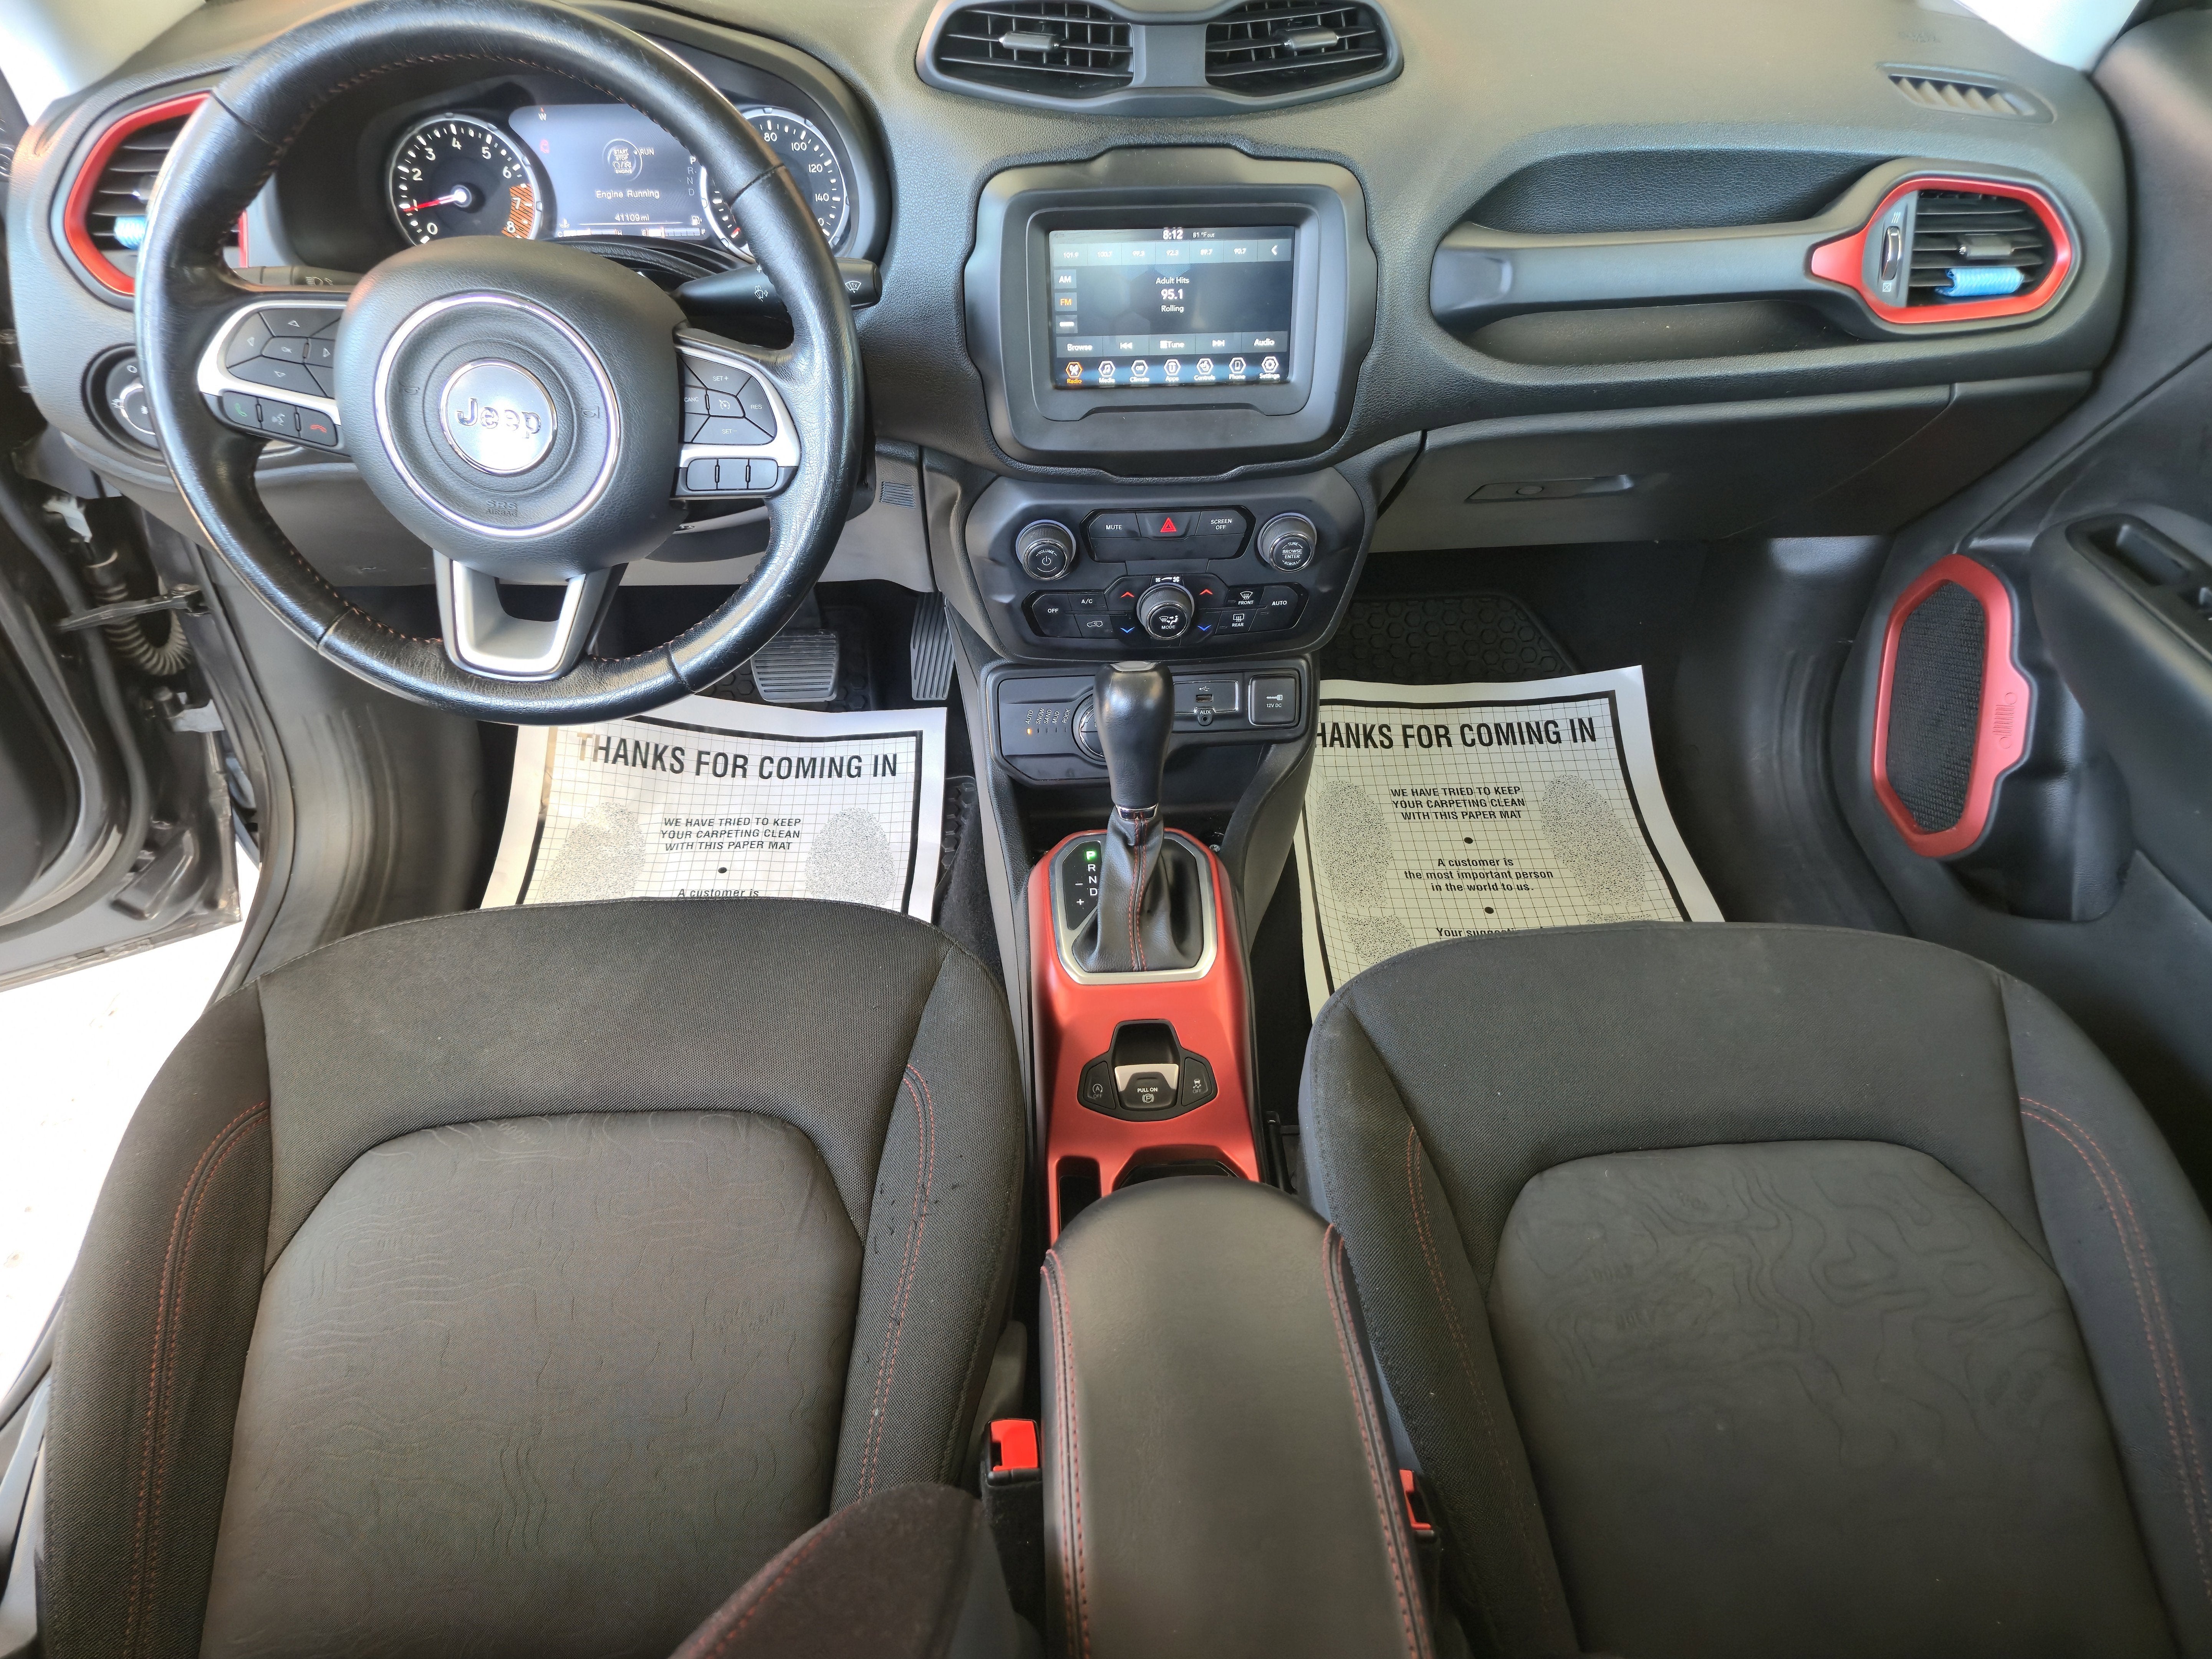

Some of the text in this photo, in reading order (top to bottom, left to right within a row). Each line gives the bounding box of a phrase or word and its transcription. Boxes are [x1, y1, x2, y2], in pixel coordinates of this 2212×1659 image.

[764, 132, 777, 142] 80
[452, 137, 461, 150] 4
[791, 142, 807, 152] 100
[425, 148, 436, 161] 3
[482, 146, 491, 159] 5
[640, 147, 654, 156] RUN
[690, 156, 697, 165] P
[502, 166, 512, 179] 6
[808, 164, 823, 173] 120
[412, 168, 423, 181] 2
[687, 177, 693, 185] N
[596, 189, 660, 200] Engine Running
[688, 188, 695, 196] D
[815, 193, 829, 202] 140
[512, 197, 521, 210] 7
[427, 222, 438, 235] 0
[506, 220, 516, 233] 8
[1163, 230, 1183, 240] 8:12
[1161, 289, 1183, 300] 95.1
[1067, 343, 1093, 351] Browse
[1253, 338, 1275, 346] Audio
[457, 398, 542, 439] Jeep
[487, 500, 518, 509] SRS
[1025, 710, 1034, 724] AUTO
[1035, 707, 1045, 725] SNOW
[1043, 709, 1052, 724] SAND
[1052, 710, 1060, 724] MUD
[1062, 708, 1071, 724] ROCK
[1316, 717, 1596, 749] HANKS FOR COMING IN
[577, 733, 897, 779] THANKS FOR COMING IN
[1391, 786, 1520, 796] WE HAVE TRIED TO KEEP
[1426, 799, 1487, 808] CARPETING
[1490, 798, 1525, 806] CLEAN
[1401, 810, 1522, 820] WITH THIS PAPER MAT
[664, 818, 681, 826] WE
[685, 818, 714, 826] HAVE
[718, 818, 750, 826] TRIED
[661, 829, 800, 839] YOUR CARPETING CLEAN
[666, 842, 693, 851] WITH
[728, 841, 764, 849] PAPER
[768, 841, 792, 849] MAT
[1086, 851, 1095, 860] P
[1504, 858, 1514, 866] is
[1404, 871, 1422, 879] the
[1457, 870, 1512, 880] important
[1515, 871, 1553, 880] person
[1431, 883, 1442, 891] in
[1445, 883, 1463, 891] the
[1467, 882, 1498, 891] world
[678, 889, 685, 897] A
[750, 889, 759, 897] is
[1089, 888, 1098, 896] D
[1436, 928, 1462, 937] Your
